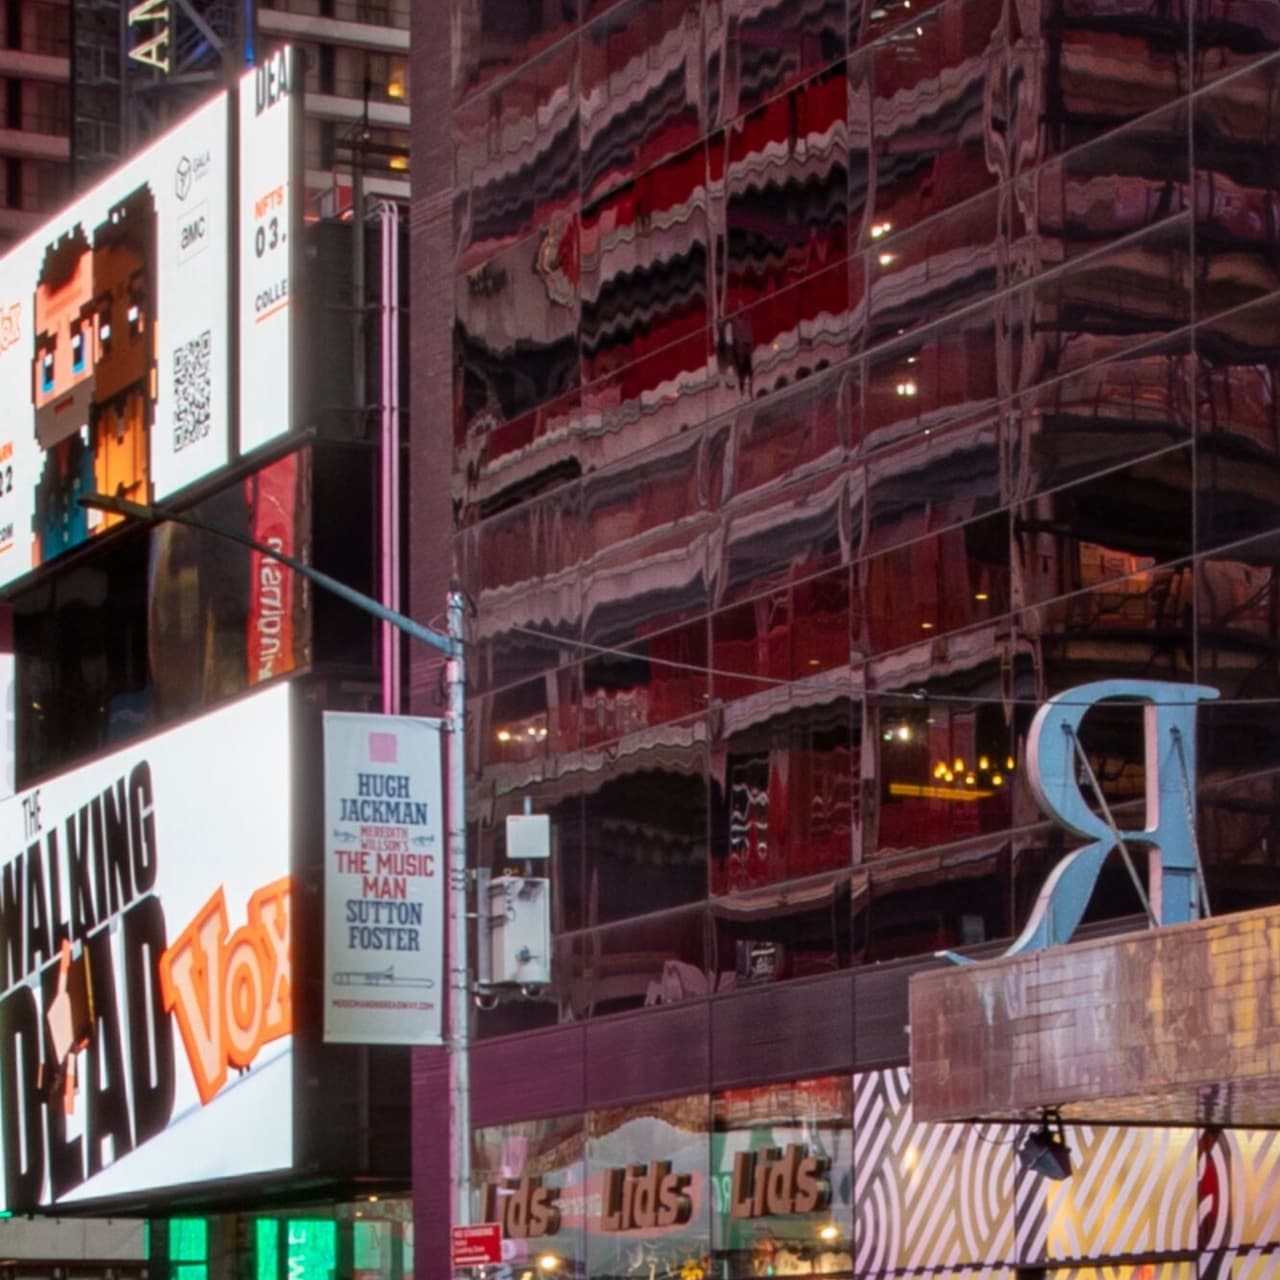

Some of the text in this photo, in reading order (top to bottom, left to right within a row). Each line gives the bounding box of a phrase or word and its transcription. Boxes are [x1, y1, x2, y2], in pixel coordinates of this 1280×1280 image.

[357, 773, 411, 799] HUGH
[22, 790, 43, 841] THE
[339, 798, 428, 826] JACKMAN
[359, 825, 409, 840] MEREDITH
[0, 759, 159, 994] WALKING
[334, 851, 435, 877] THE MUSIC
[361, 877, 407, 900] MAN
[345, 899, 423, 925] SUTTON
[348, 925, 421, 951] FOSTER
[731, 1143, 832, 1219] Lids
[600, 1160, 694, 1231] Lids
